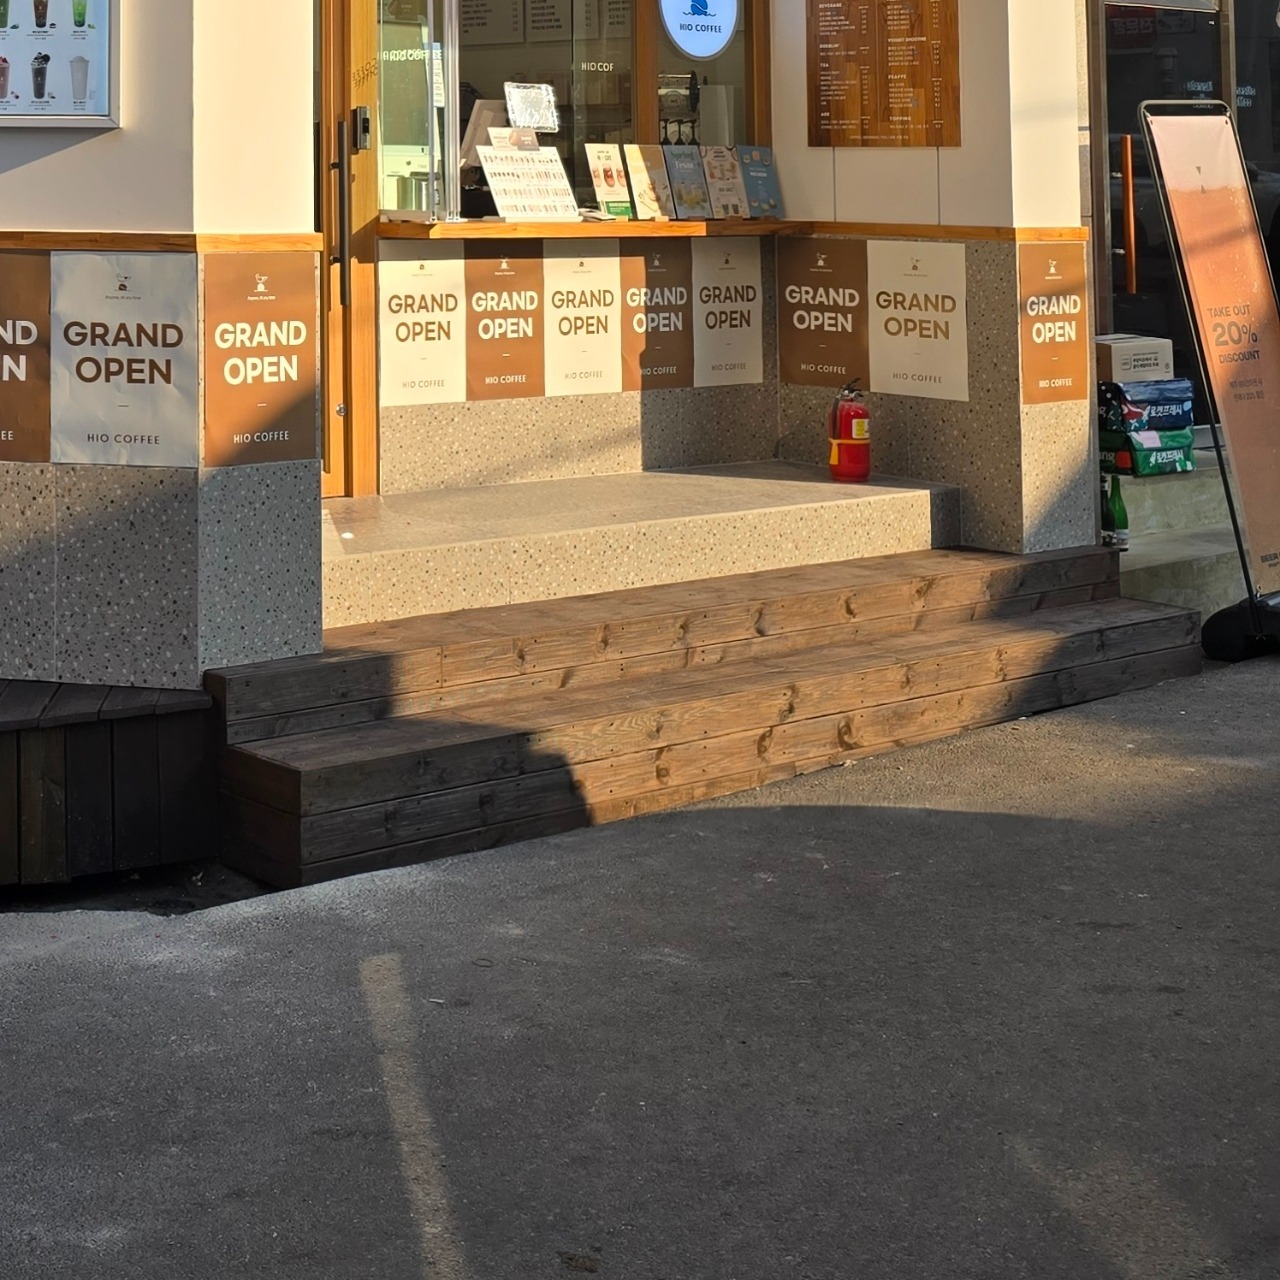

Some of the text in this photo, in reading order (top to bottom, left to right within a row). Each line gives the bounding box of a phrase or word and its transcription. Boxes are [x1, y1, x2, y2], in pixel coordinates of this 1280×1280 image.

[679, 23, 722, 33] HIO COFFEE
[581, 62, 596, 71] HIO
[388, 293, 458, 314] GRAND
[471, 290, 539, 313] GRAND
[551, 289, 615, 309] GRAND
[626, 286, 688, 308] GRAND
[698, 284, 757, 305] GRAND
[785, 285, 860, 308] GRAND
[875, 290, 957, 314] GRAND
[1026, 294, 1081, 317] GRAND
[1207, 305, 1250, 318] TAKE OUT
[477, 317, 534, 340] OPEN
[558, 315, 609, 336] OPEN
[632, 311, 683, 334] OPEN
[704, 309, 752, 330] OPEN
[792, 310, 853, 333] OPEN
[883, 316, 950, 340] OPEN
[63, 321, 184, 348] GRAND
[214, 320, 307, 349] GRAND
[395, 320, 452, 343] OPEN
[1032, 321, 1076, 344] OPEN
[1212, 321, 1258, 346] 20%
[712, 362, 747, 372] HIO COFFEE
[1218, 350, 1260, 363] DISCOUNT
[75, 356, 173, 385] OPEN
[223, 354, 298, 386] OPEN
[485, 374, 527, 385] HIO COFFEE
[564, 370, 603, 380] HIO COFFEE
[640, 366, 677, 376] HIO COFFEE
[801, 363, 846, 375] HIO COFFEE
[892, 372, 943, 384] HIO COFFEE
[402, 379, 445, 389] HIO COFFEE
[1050, 377, 1073, 388] COFFEE
[1150, 405, 1182, 416] 로켓프레시
[87, 433, 161, 445] HIO COFFEE
[233, 431, 289, 444] HIO COFFEE
[1156, 449, 1184, 463] 로켓프레시
